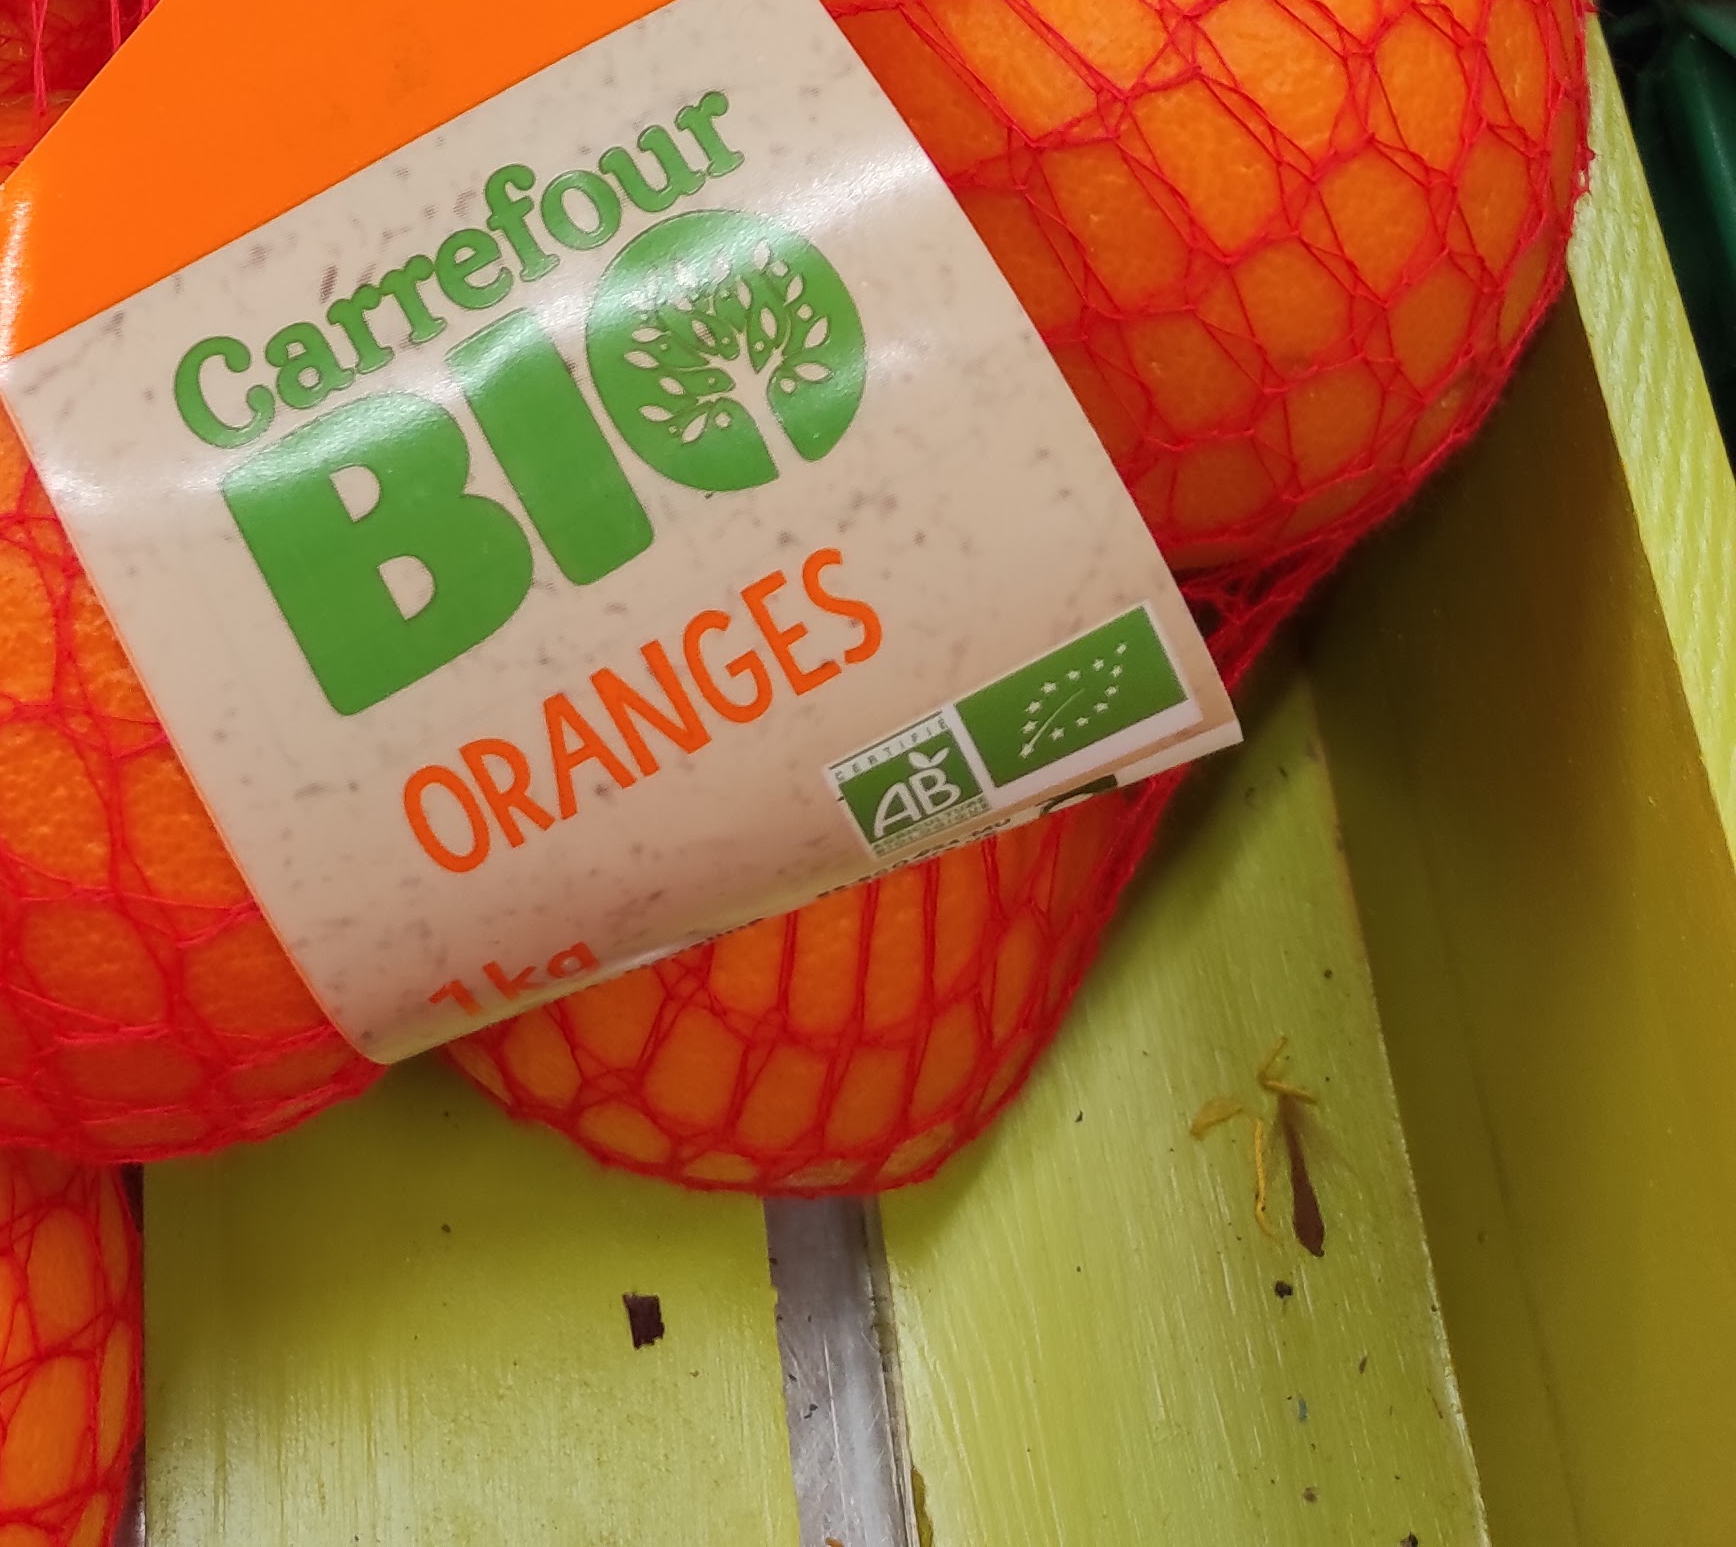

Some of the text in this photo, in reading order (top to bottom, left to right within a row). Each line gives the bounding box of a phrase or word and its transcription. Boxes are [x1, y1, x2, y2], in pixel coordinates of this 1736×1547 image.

[171, 89, 747, 450] Carrefour
[218, 207, 866, 719] BIO
[401, 546, 885, 875] ORANGES
[873, 768, 962, 839] AB
